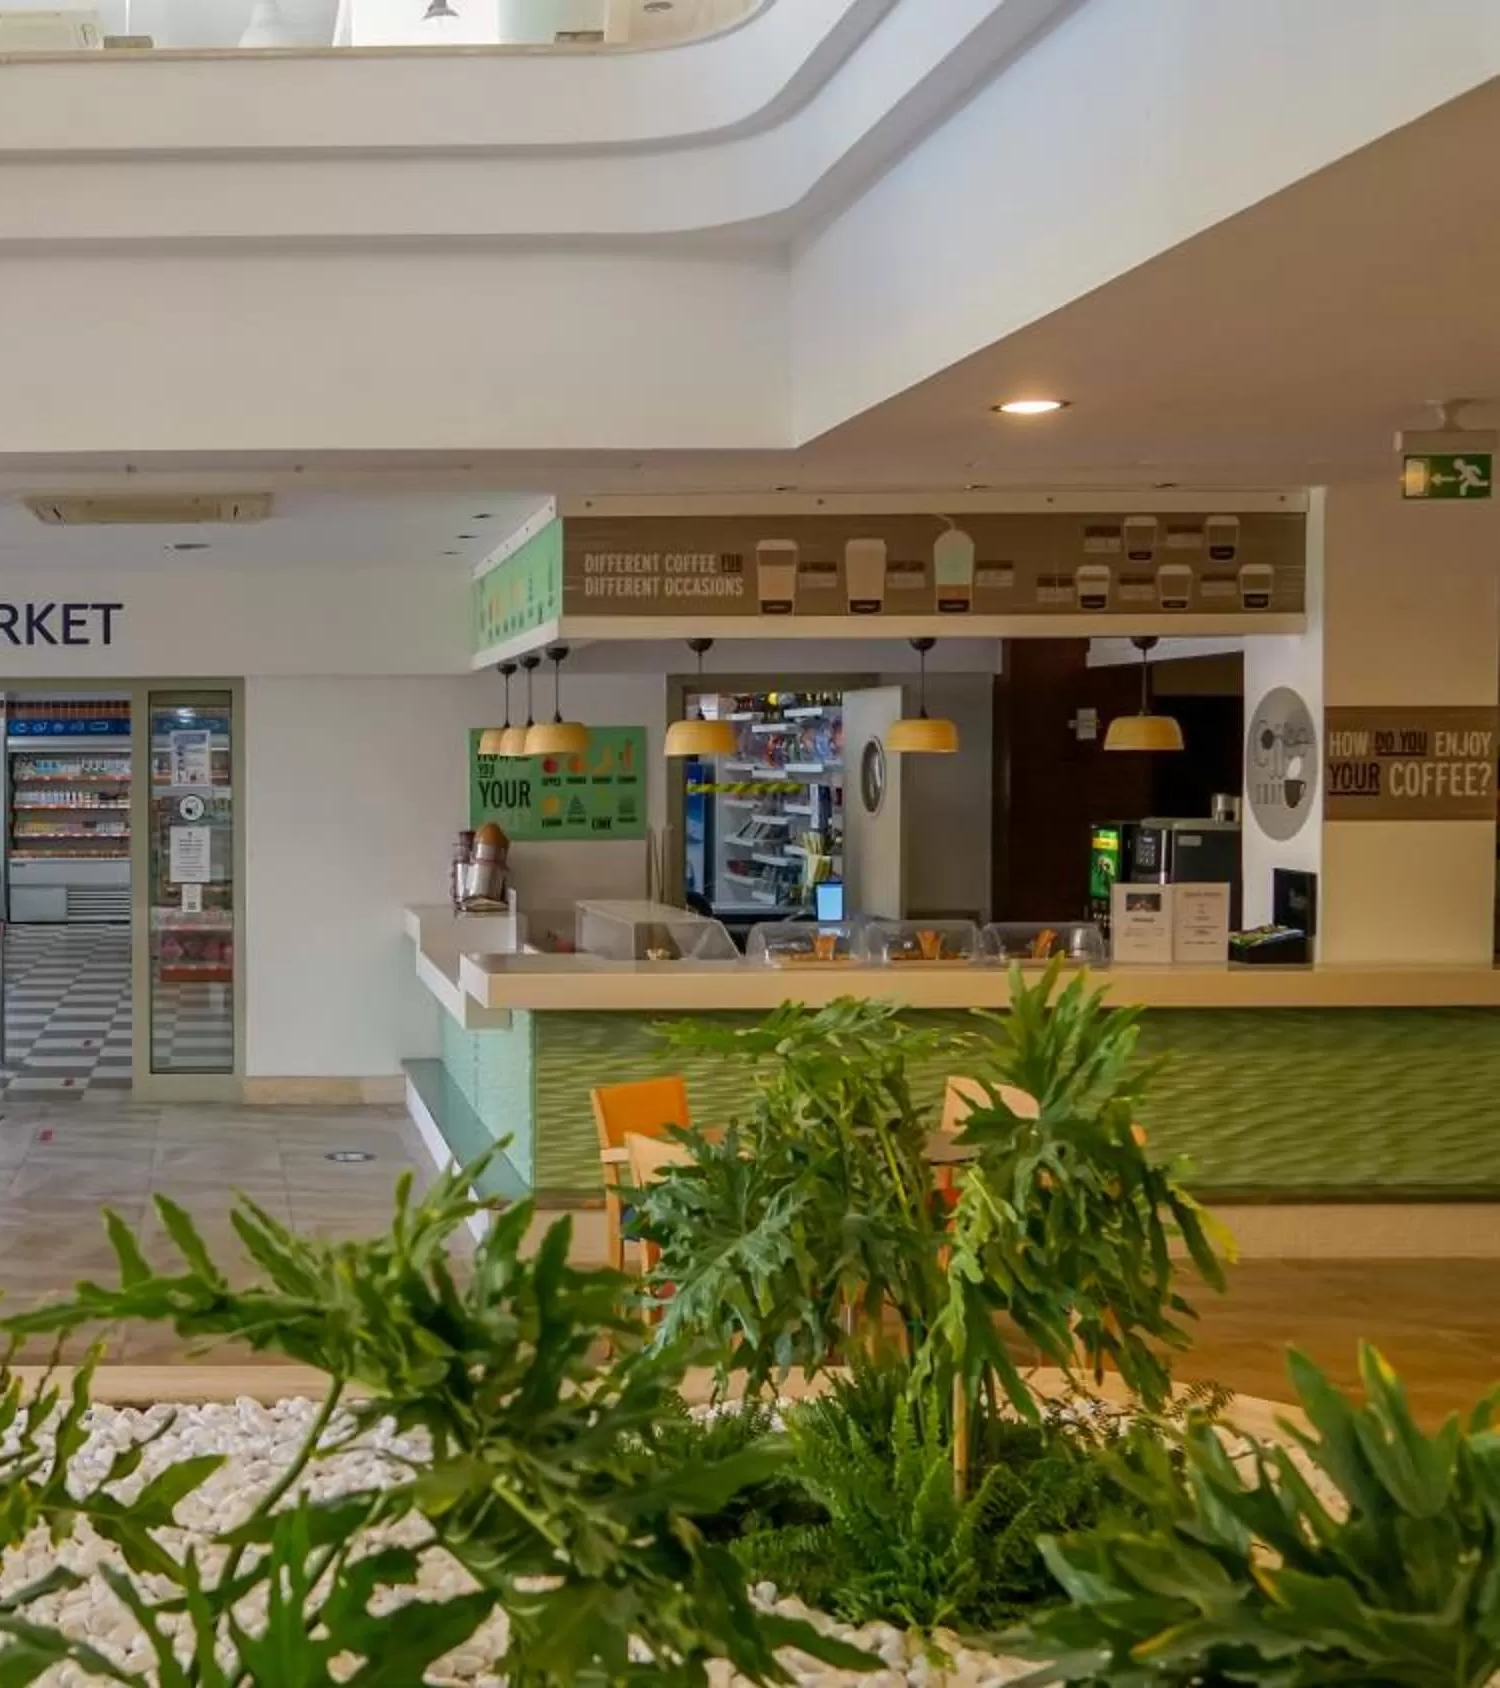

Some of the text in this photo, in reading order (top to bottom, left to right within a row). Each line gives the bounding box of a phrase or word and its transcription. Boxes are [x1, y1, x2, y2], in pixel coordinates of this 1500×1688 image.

[584, 553, 660, 574] DIFFERENT
[665, 553, 717, 574] COFFEE
[585, 576, 744, 597] DIFFERENT OCCASIONS
[1329, 731, 1369, 757] HOW
[1399, 731, 1428, 753] YOU
[1435, 731, 1493, 757] ENJOY
[1329, 761, 1493, 797] YOUR COFFEE?
[478, 780, 531, 809] YOUR
